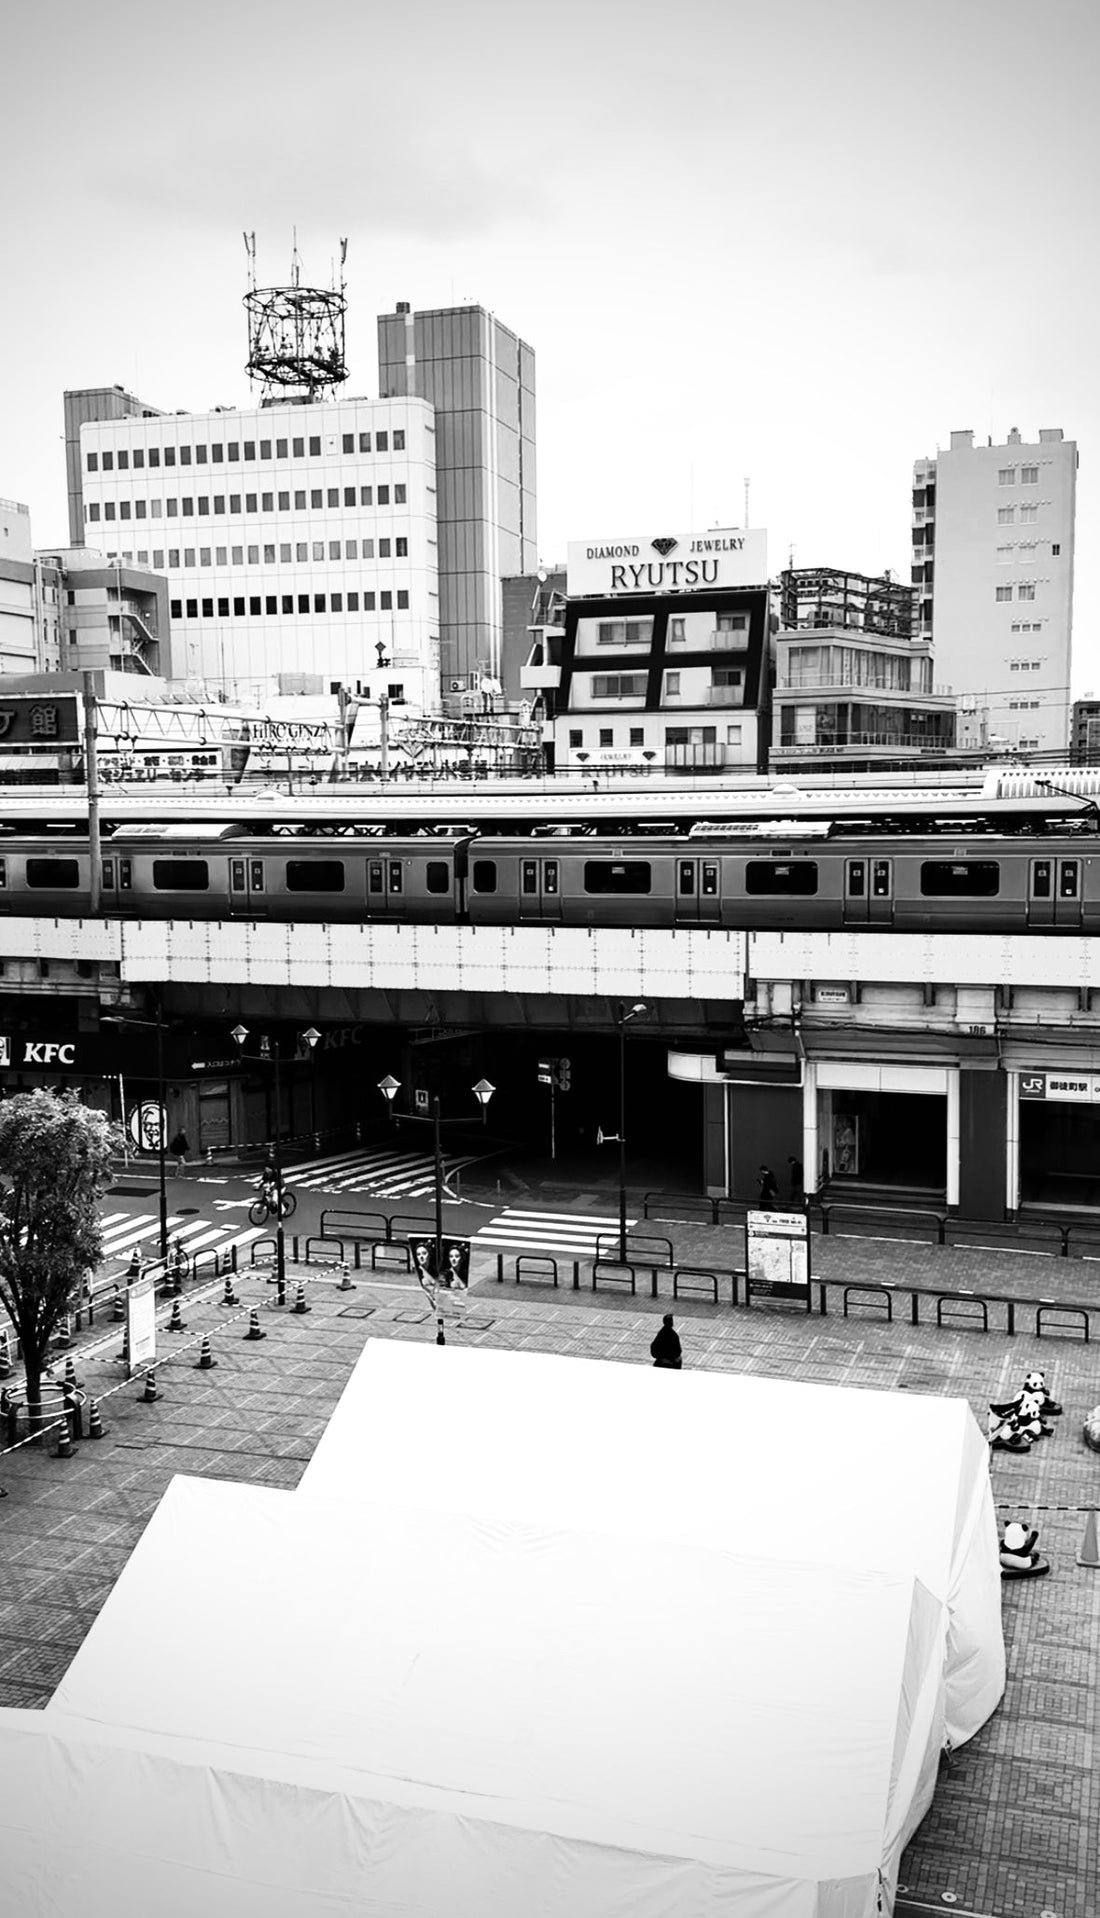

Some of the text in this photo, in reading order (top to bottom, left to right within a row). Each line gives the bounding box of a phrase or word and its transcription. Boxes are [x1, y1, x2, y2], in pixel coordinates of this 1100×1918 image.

[587, 538, 746, 559] DIAMOND JEWELRY
[611, 559, 719, 589] RYUTSU
[324, 1025, 363, 1049] KFC
[968, 1025, 986, 1035] 186
[23, 1042, 75, 1064] KFC
[1022, 1078, 1043, 1090] JR
[1049, 1081, 1088, 1092] 御徒町駅
